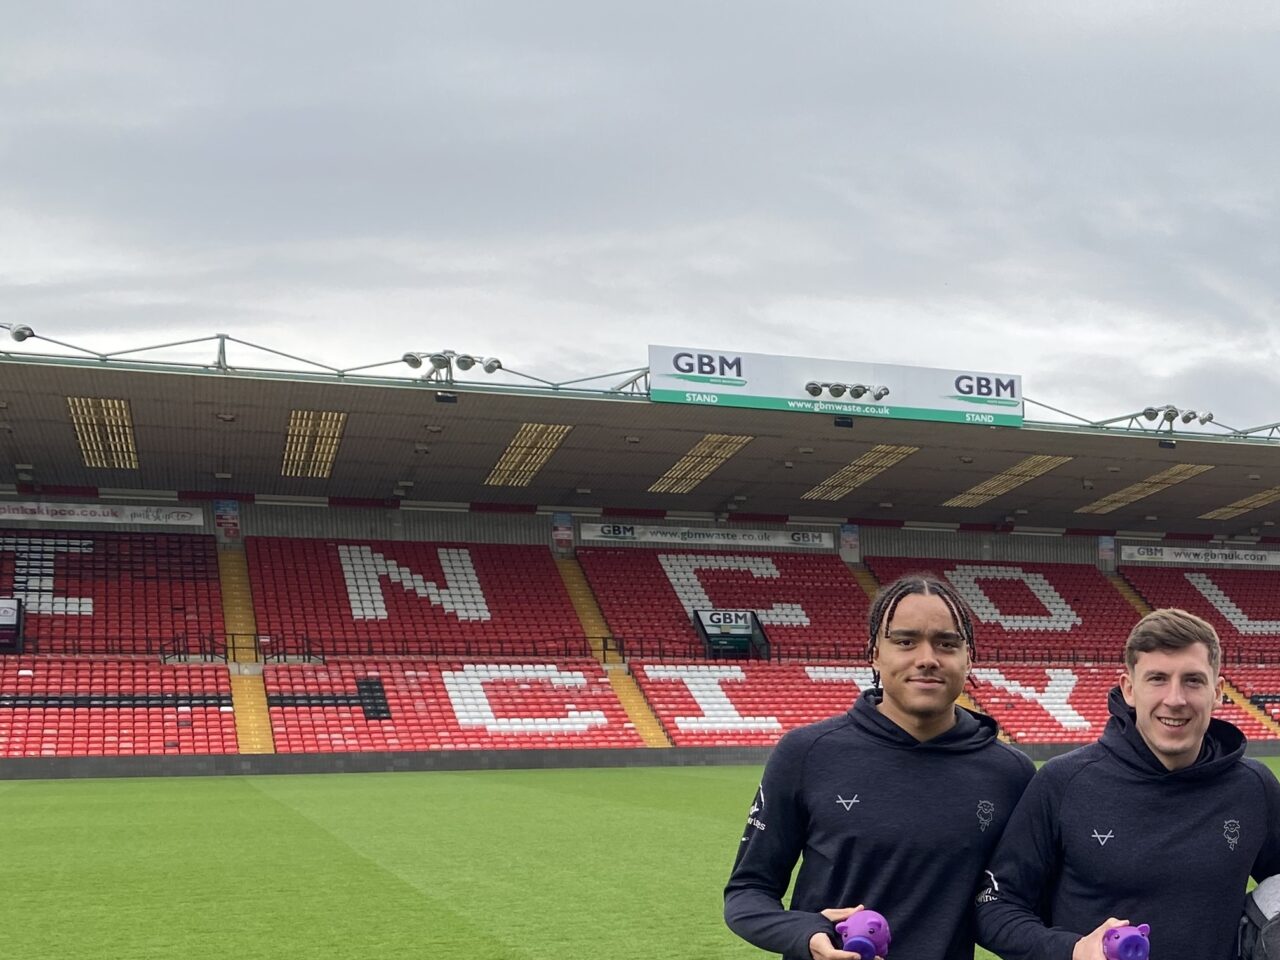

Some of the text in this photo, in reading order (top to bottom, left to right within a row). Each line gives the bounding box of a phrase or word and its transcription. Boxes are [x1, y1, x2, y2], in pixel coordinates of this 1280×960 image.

[672, 352, 742, 377] GBM
[954, 375, 1016, 398] GBM
[685, 392, 719, 404] STAND
[788, 400, 890, 416] www.gbmwaste.co.uk
[965, 413, 995, 423] STAND
[600, 523, 635, 537] GBM
[649, 528, 771, 542] www.gbmwaste.co.uk
[790, 531, 823, 543] GBM
[1137, 547, 1164, 557] GBM
[1174, 549, 1267, 562] www.gbmuk.com
[709, 612, 749, 625] GBM
